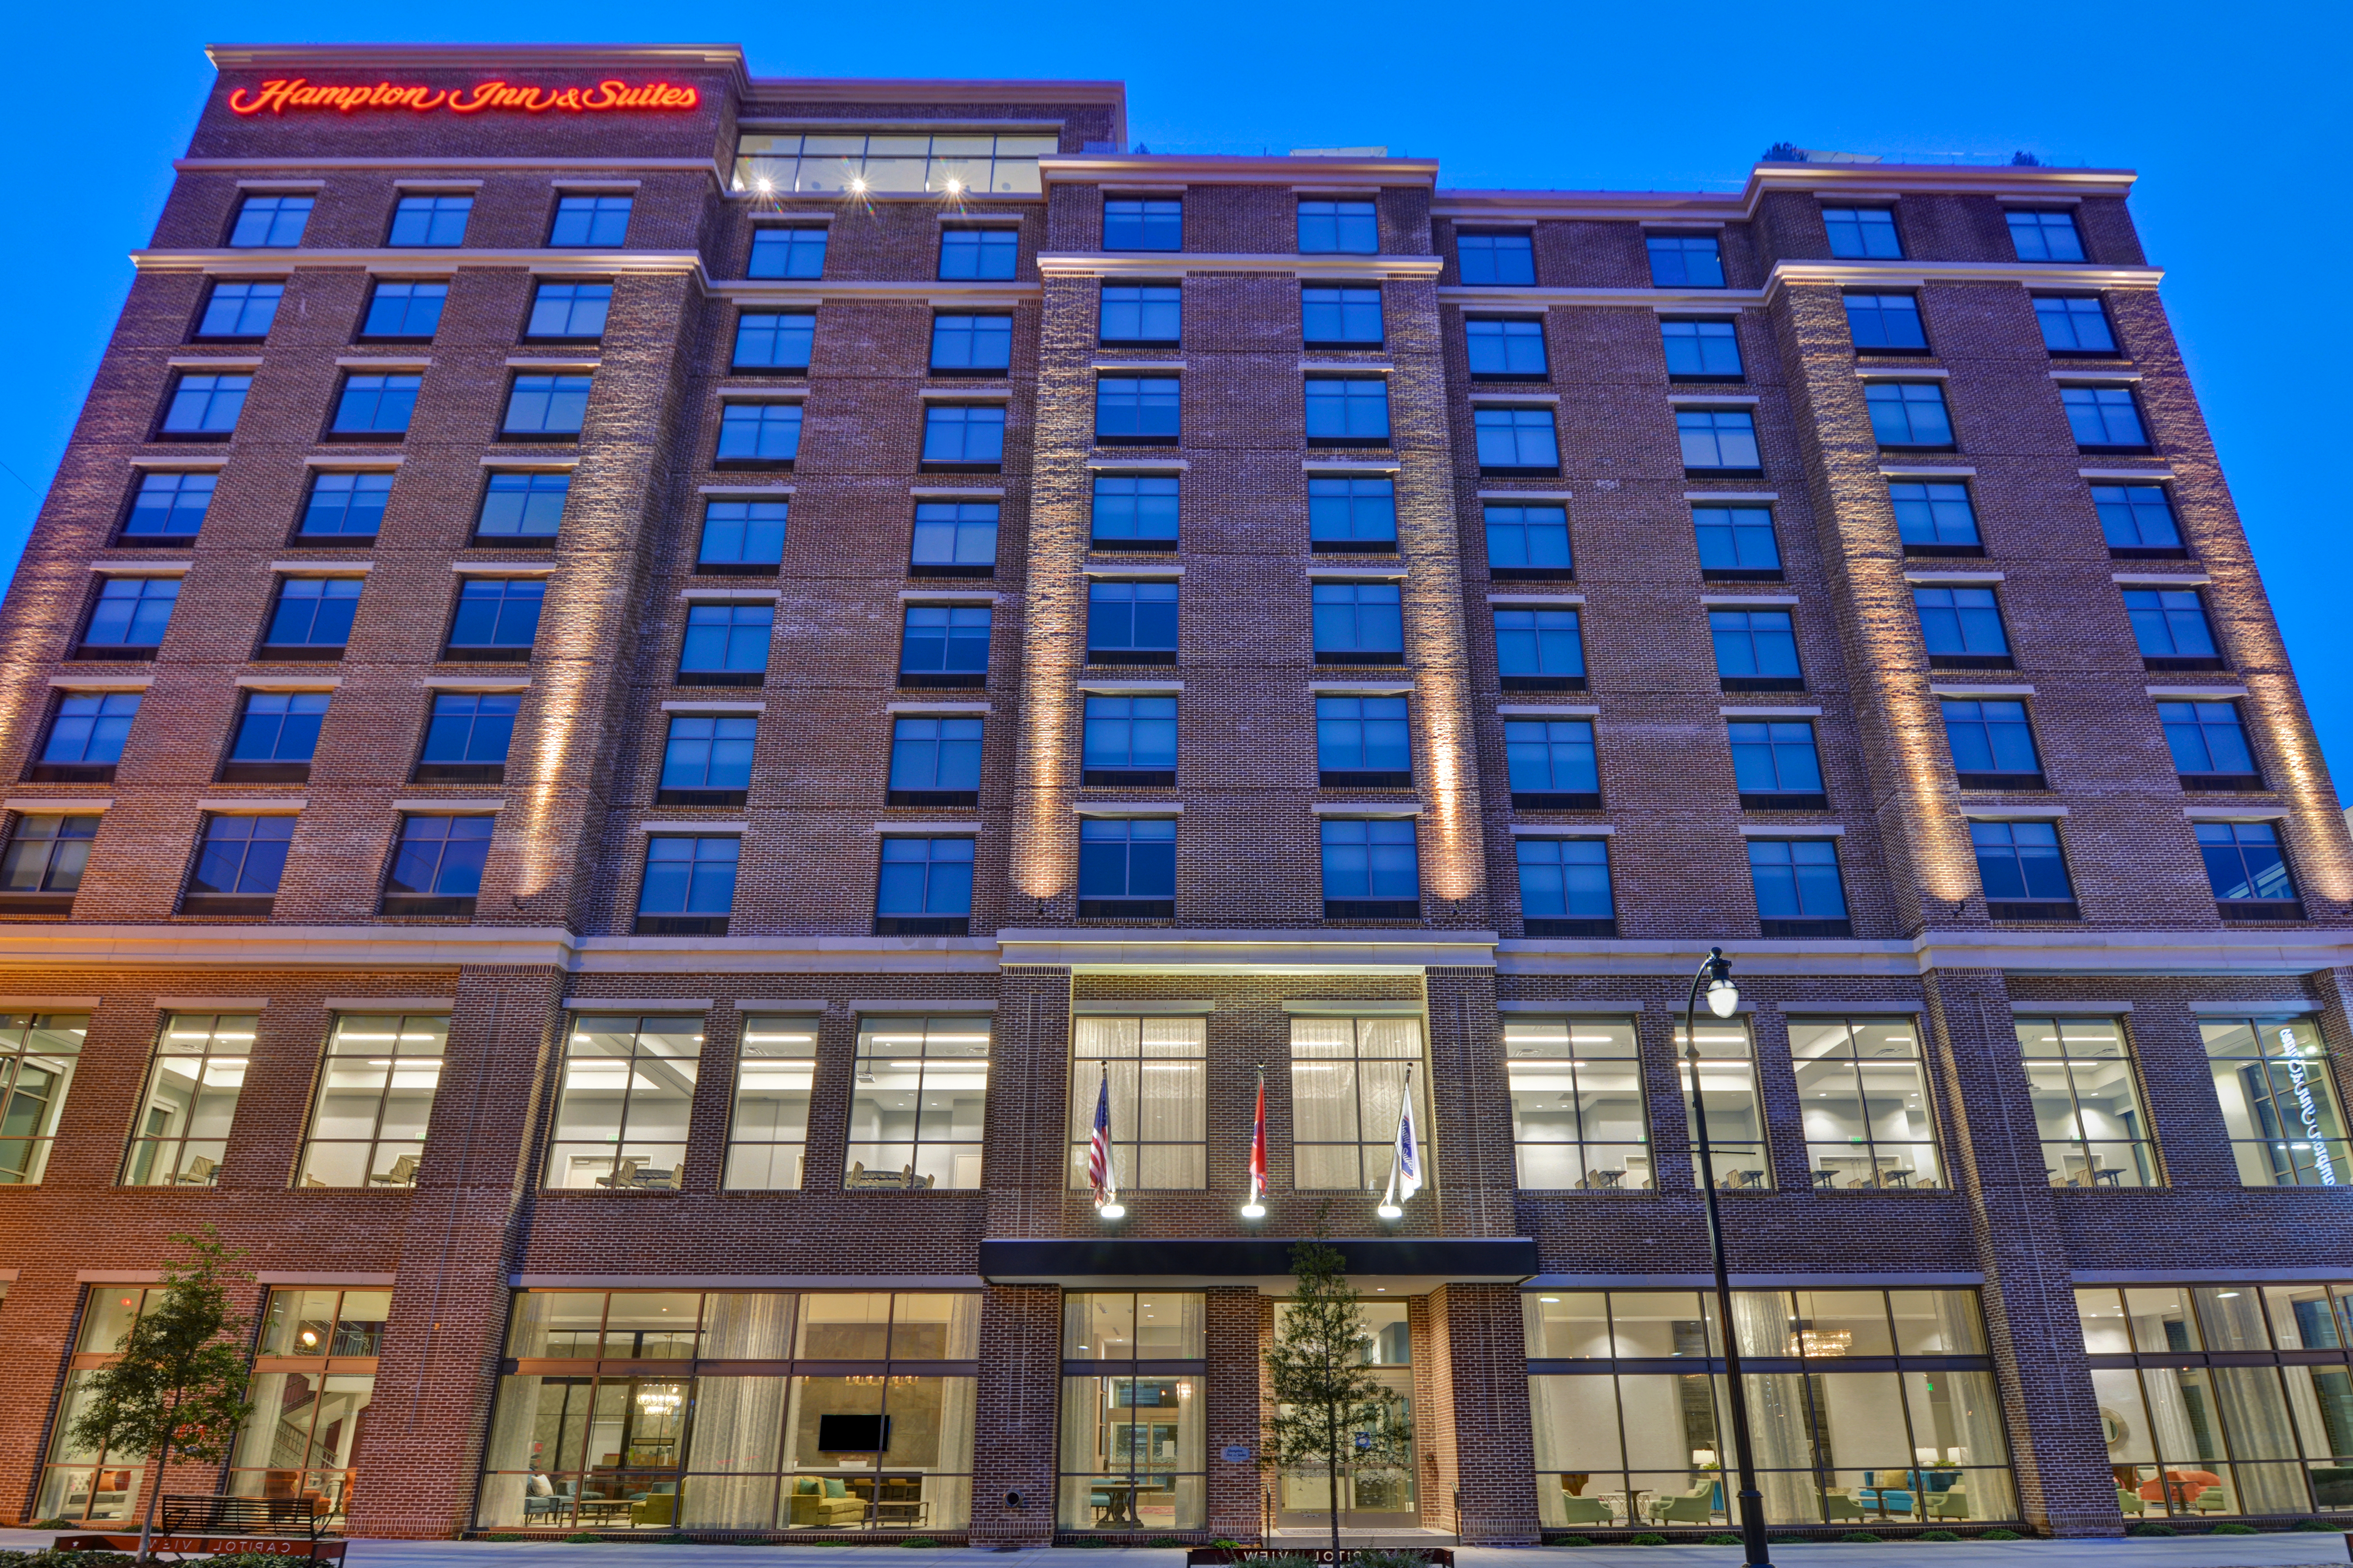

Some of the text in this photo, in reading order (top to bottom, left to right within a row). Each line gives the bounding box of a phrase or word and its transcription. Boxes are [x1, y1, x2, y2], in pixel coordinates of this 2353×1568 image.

[230, 78, 697, 114] Hampton Inn & Suites
